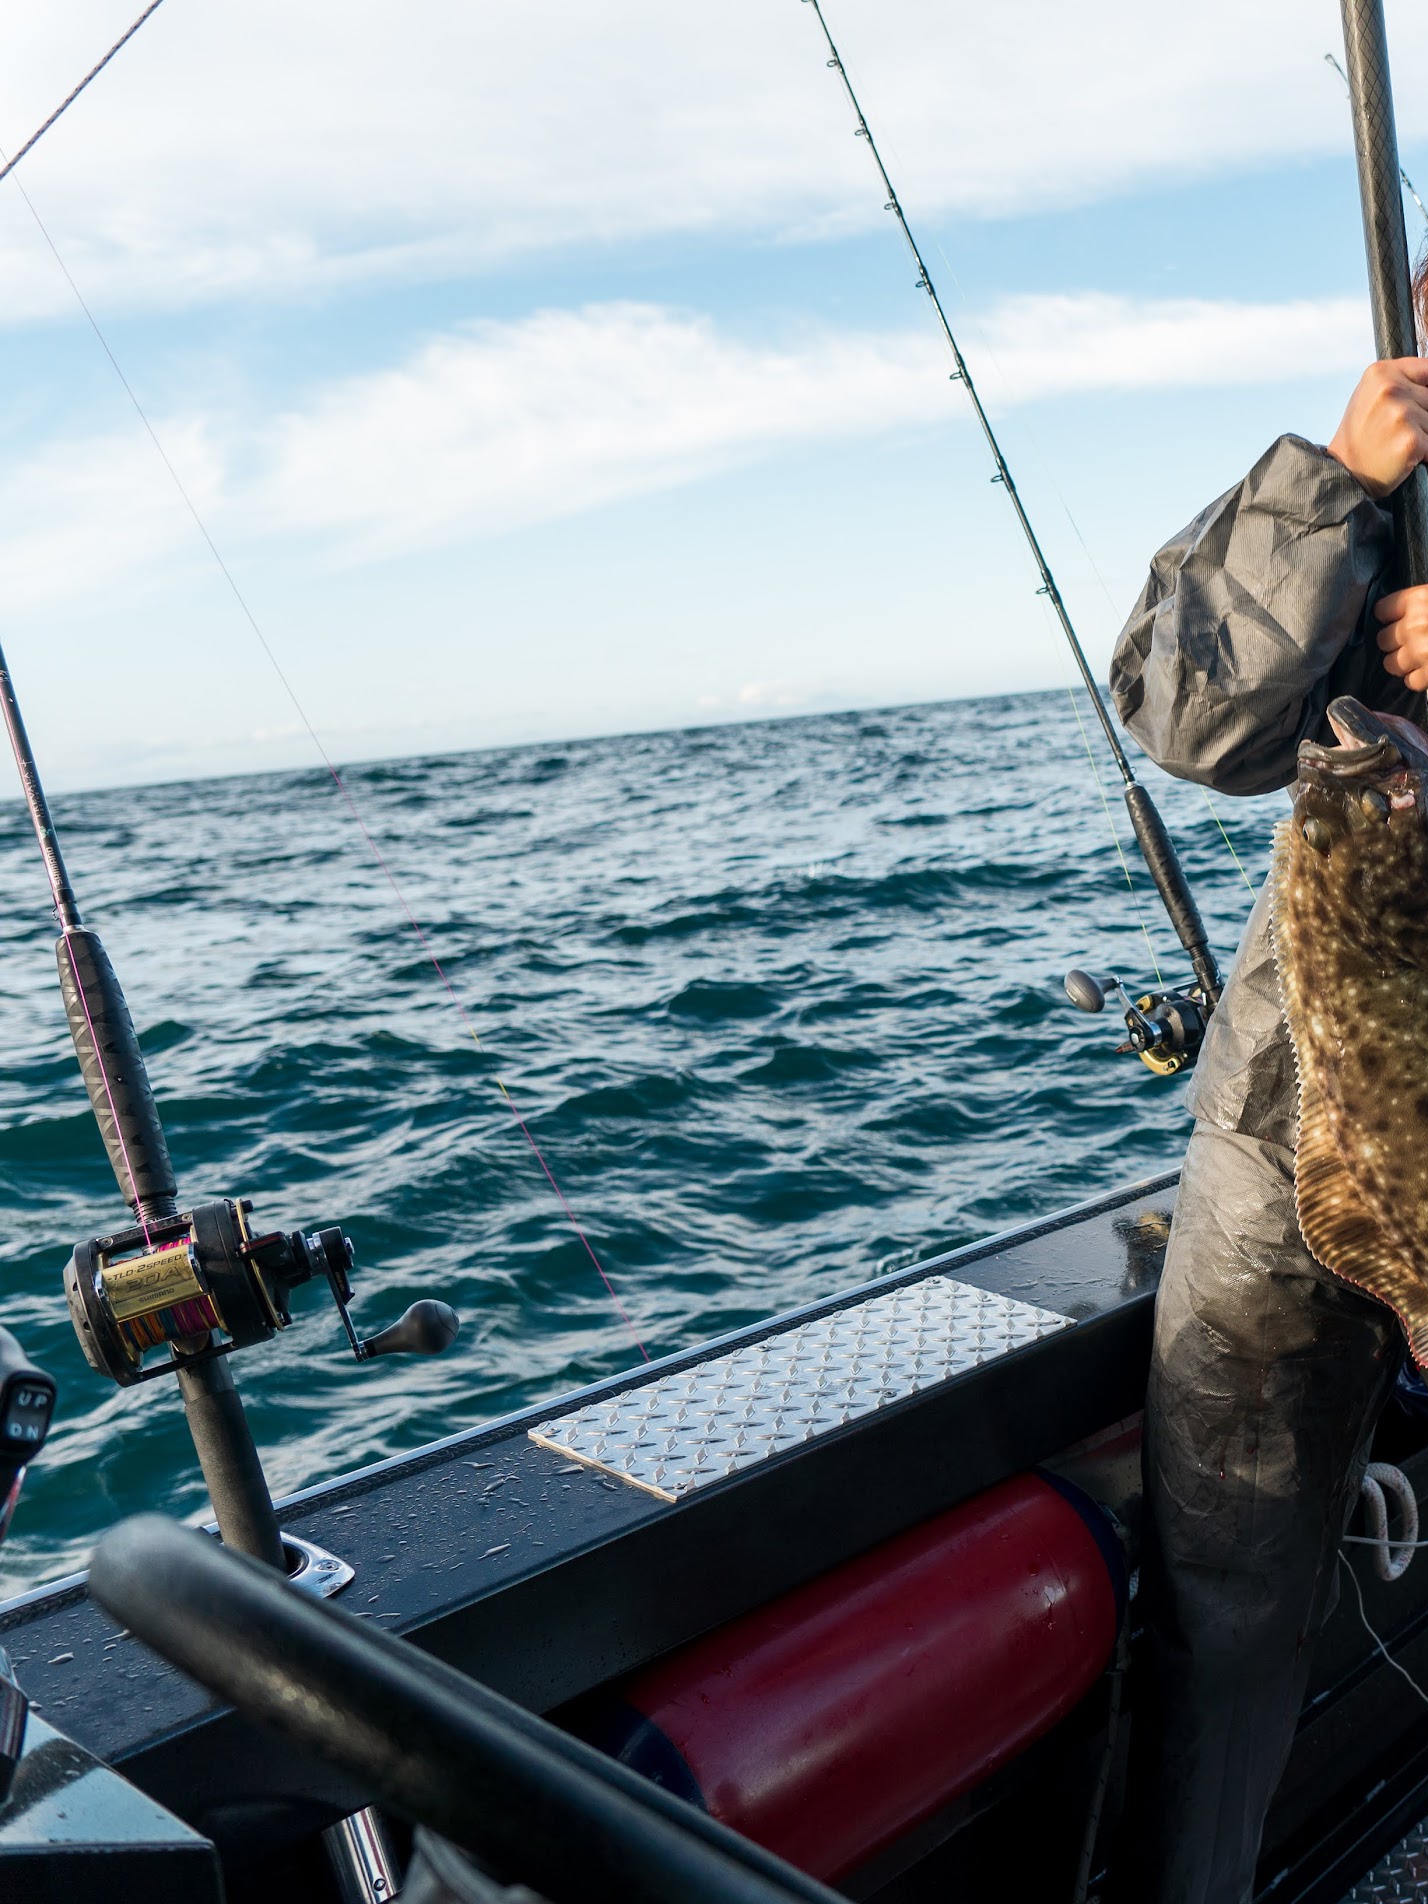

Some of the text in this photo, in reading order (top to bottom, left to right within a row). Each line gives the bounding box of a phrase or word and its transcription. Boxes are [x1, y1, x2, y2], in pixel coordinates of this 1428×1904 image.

[46, 846, 63, 886] SHIMANO
[138, 1287, 175, 1303] SHIMANO
[18, 1391, 48, 1408] UP
[9, 1423, 39, 1440] DN
